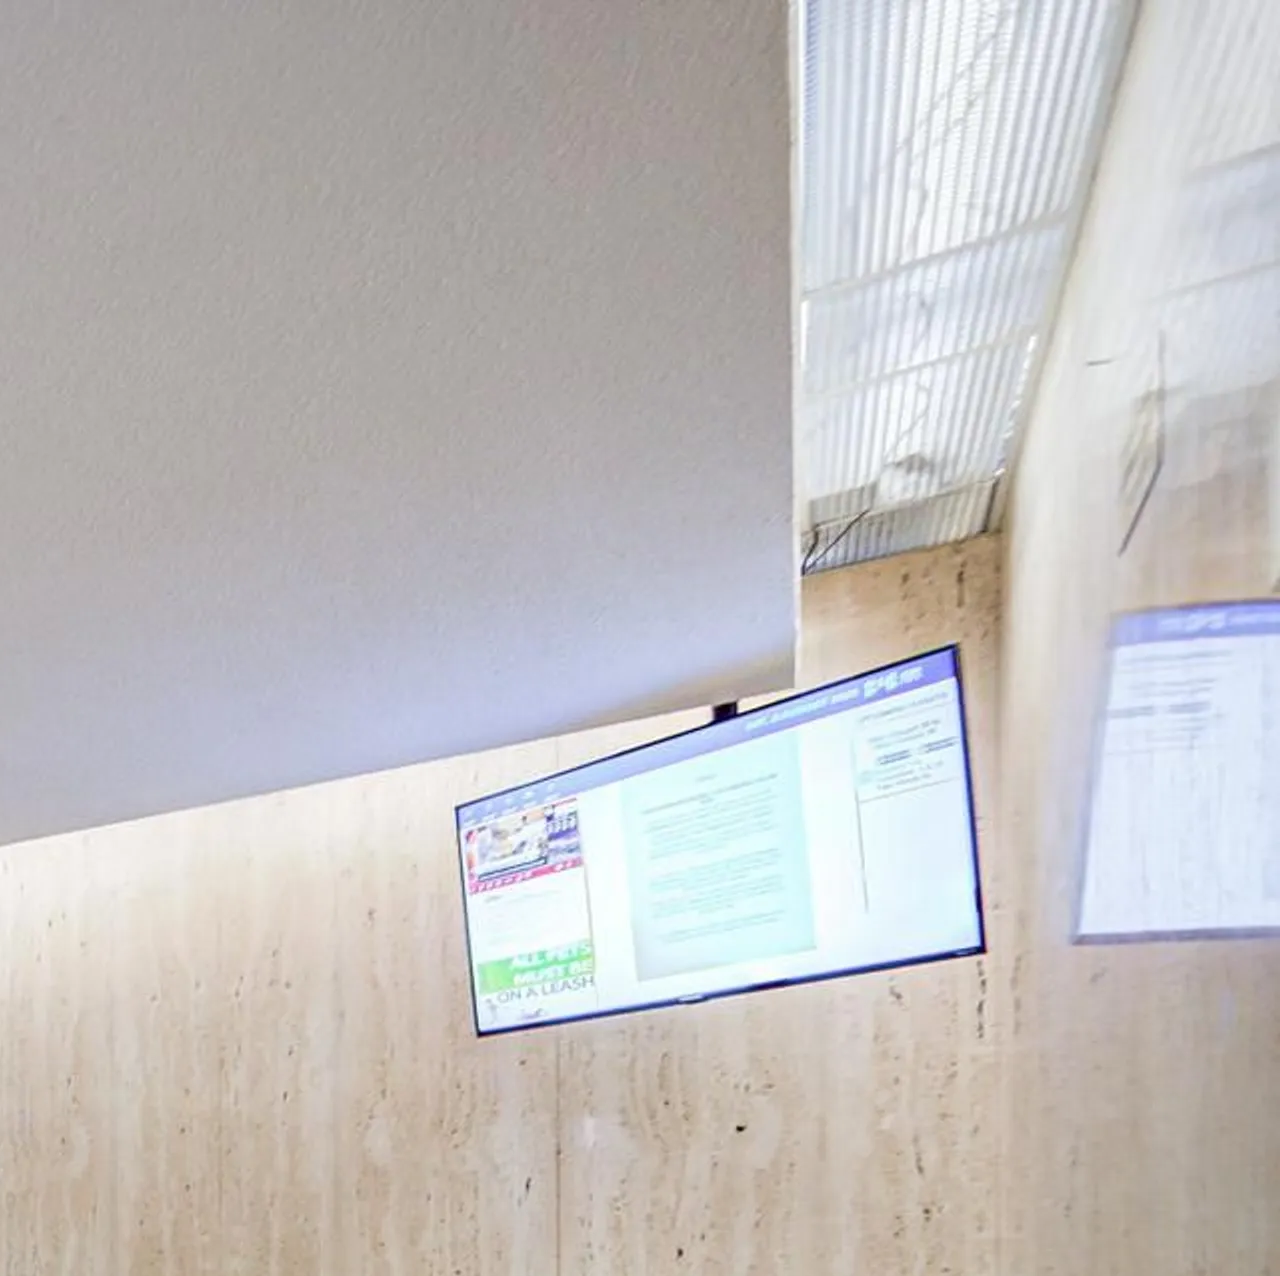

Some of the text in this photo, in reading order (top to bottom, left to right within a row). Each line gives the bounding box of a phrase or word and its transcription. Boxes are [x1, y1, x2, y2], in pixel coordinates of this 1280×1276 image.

[497, 975, 594, 1004] ON A LEASH
